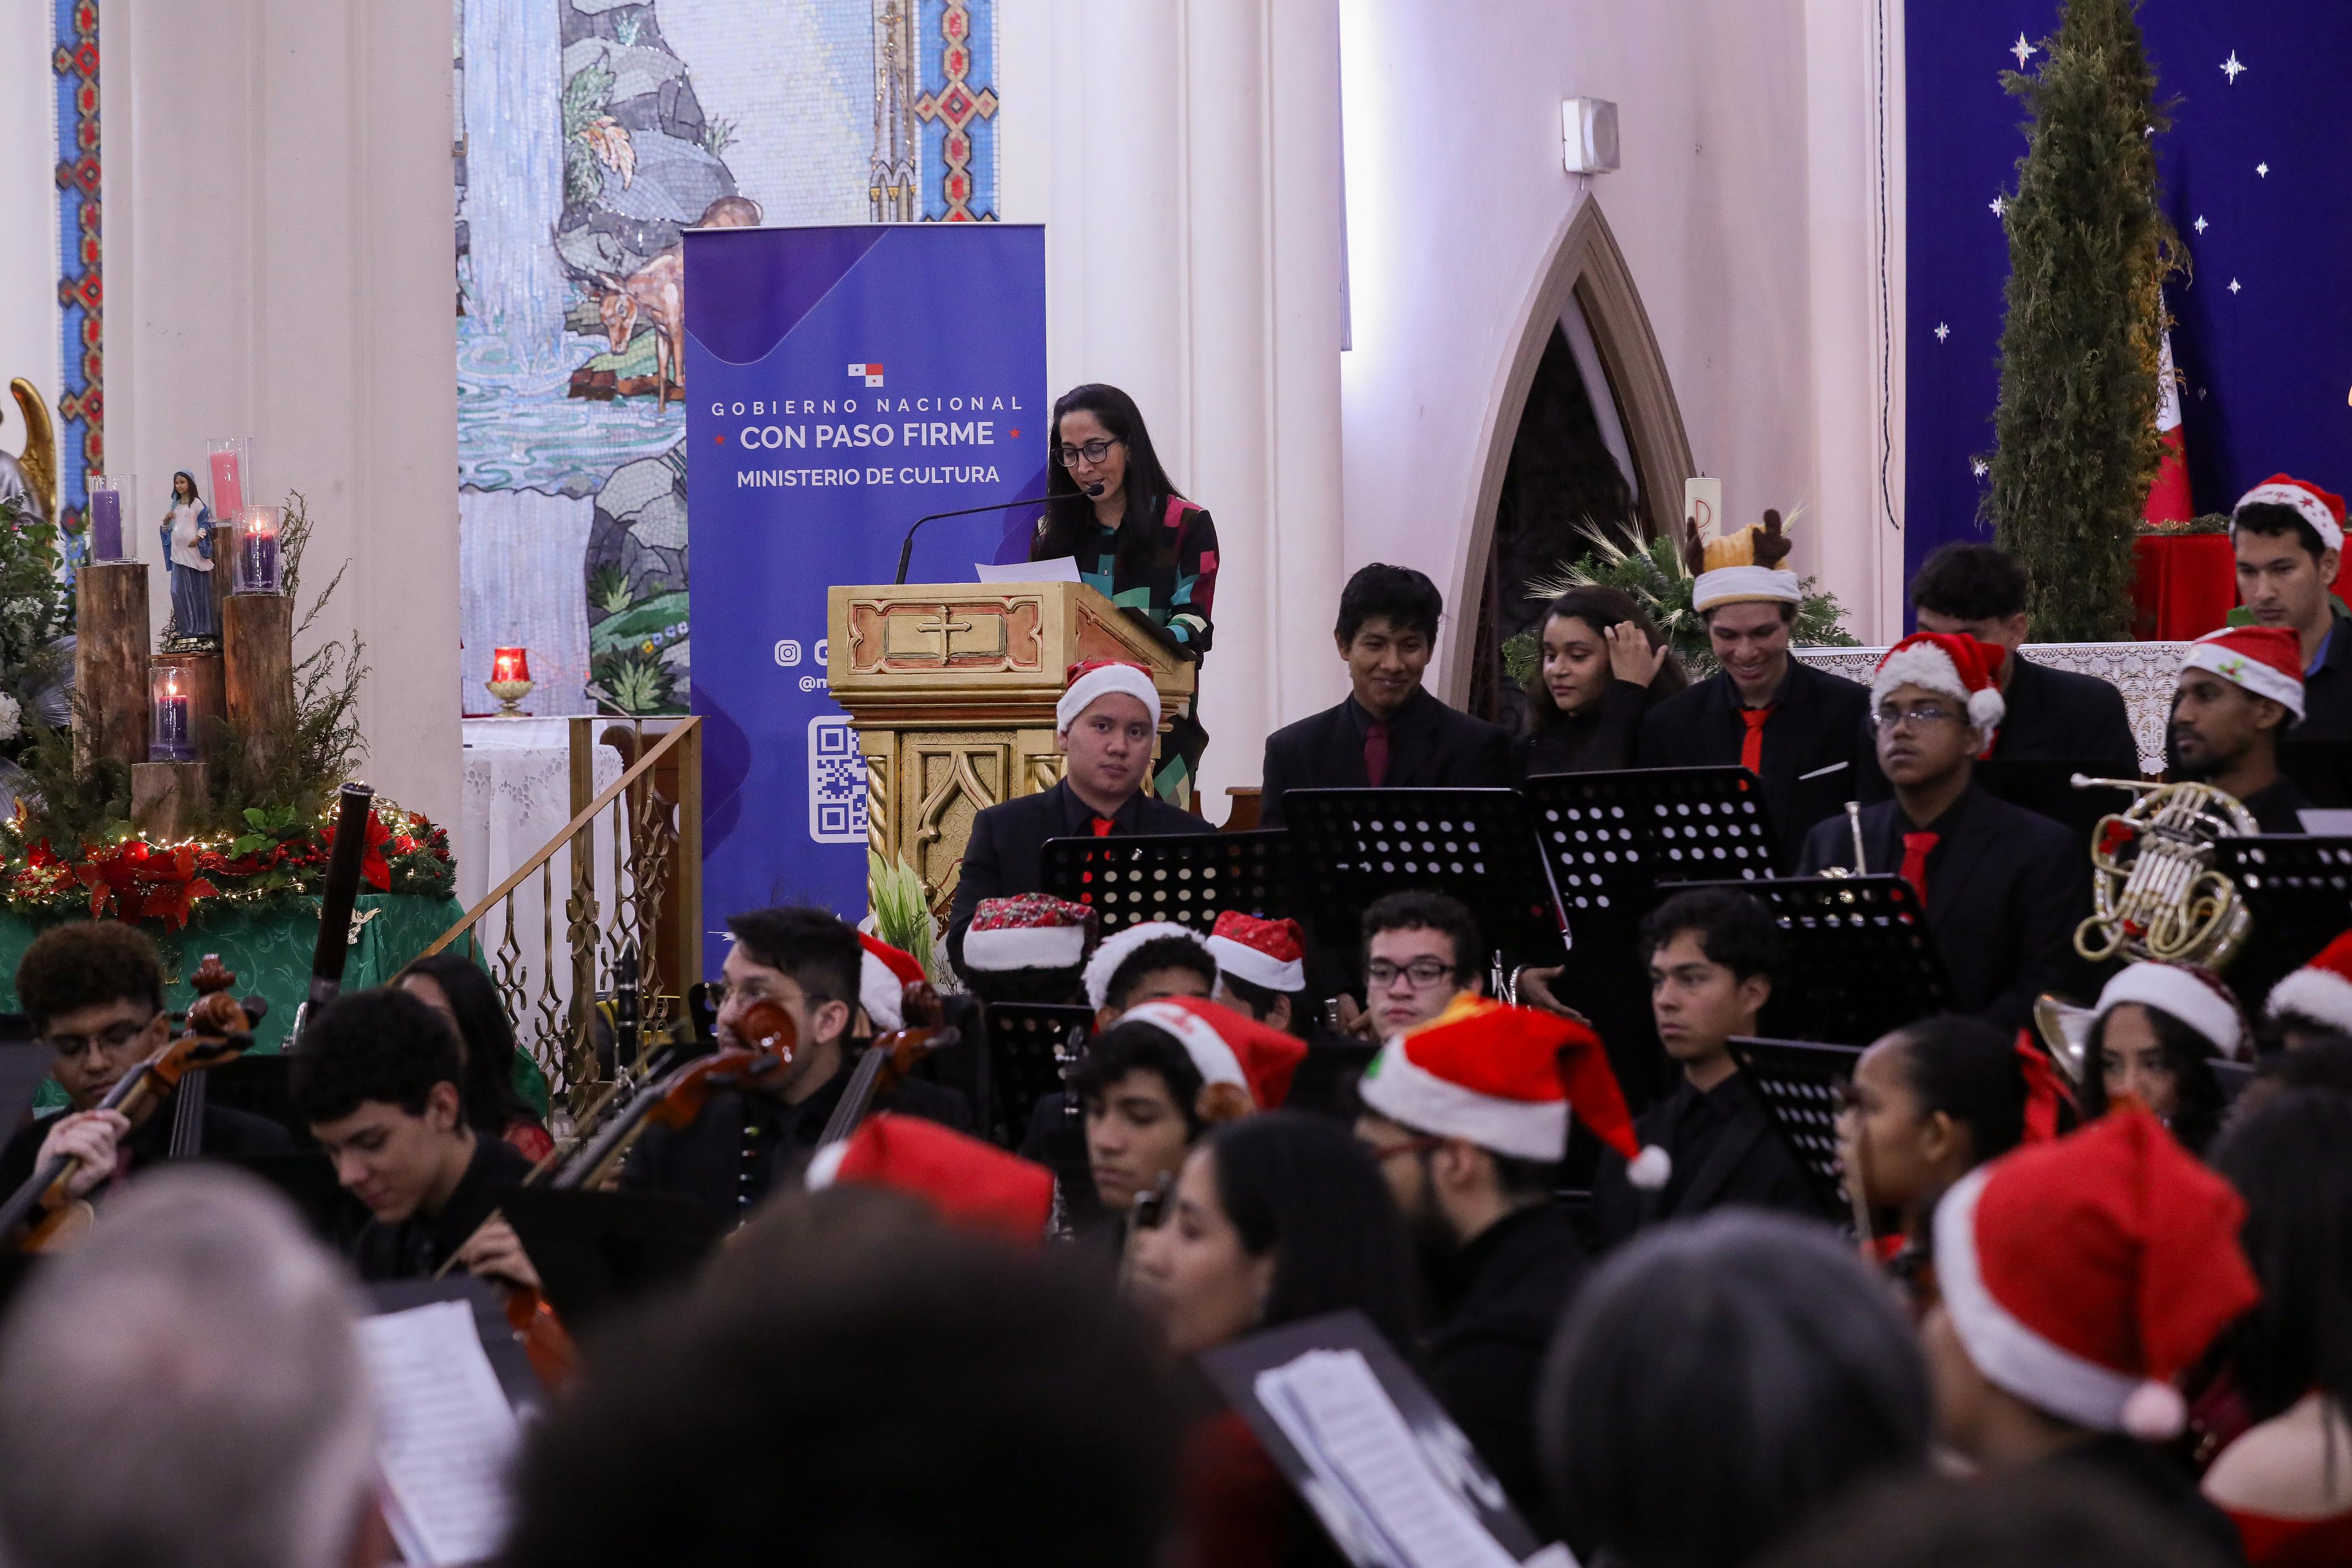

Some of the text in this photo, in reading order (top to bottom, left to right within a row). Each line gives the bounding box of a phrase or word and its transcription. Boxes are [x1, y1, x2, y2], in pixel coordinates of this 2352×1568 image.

[711, 396, 1022, 417] GOBIERNO NACIONAL
[740, 422, 995, 449] CON PASO FIRME
[737, 466, 1000, 488] MINISTERIO DE CULTURA
